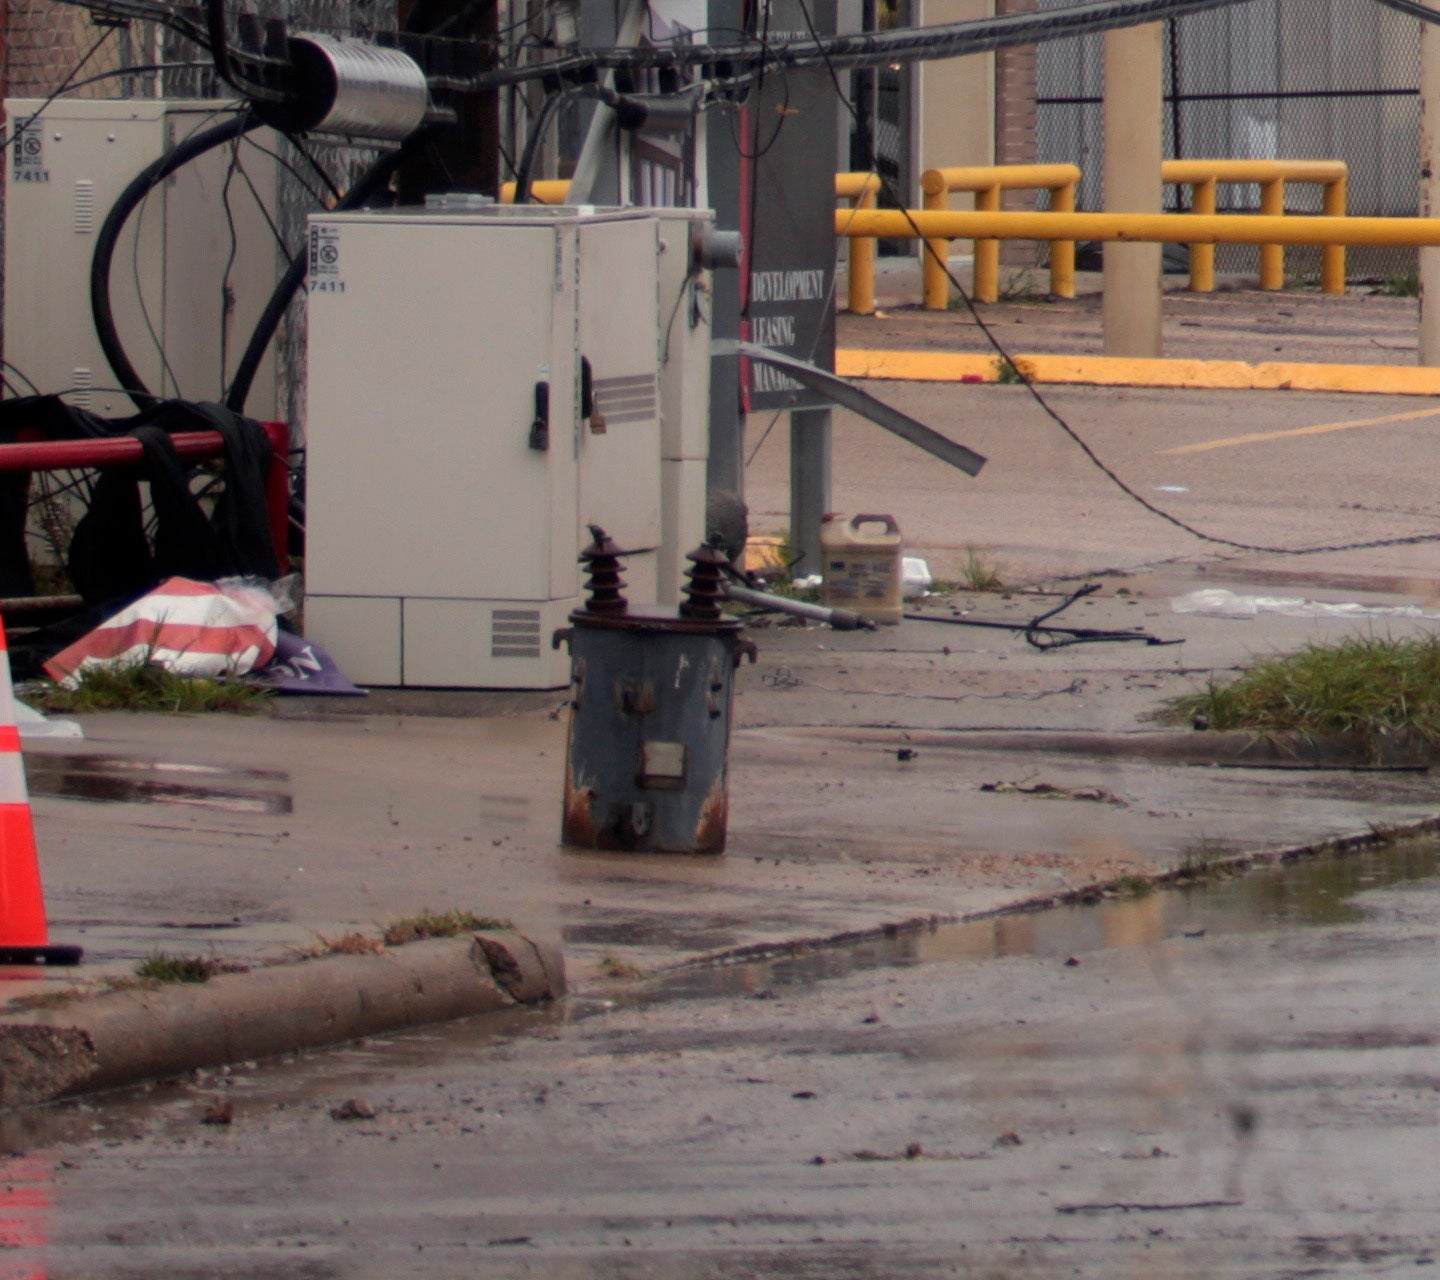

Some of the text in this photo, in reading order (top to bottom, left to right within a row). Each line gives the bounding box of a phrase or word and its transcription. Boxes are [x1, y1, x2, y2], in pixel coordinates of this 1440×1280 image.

[14, 170, 50, 182] 7411
[309, 280, 345, 293] 7411
[752, 270, 825, 302] DEVELOPMENT
[752, 316, 796, 347] LEASING
